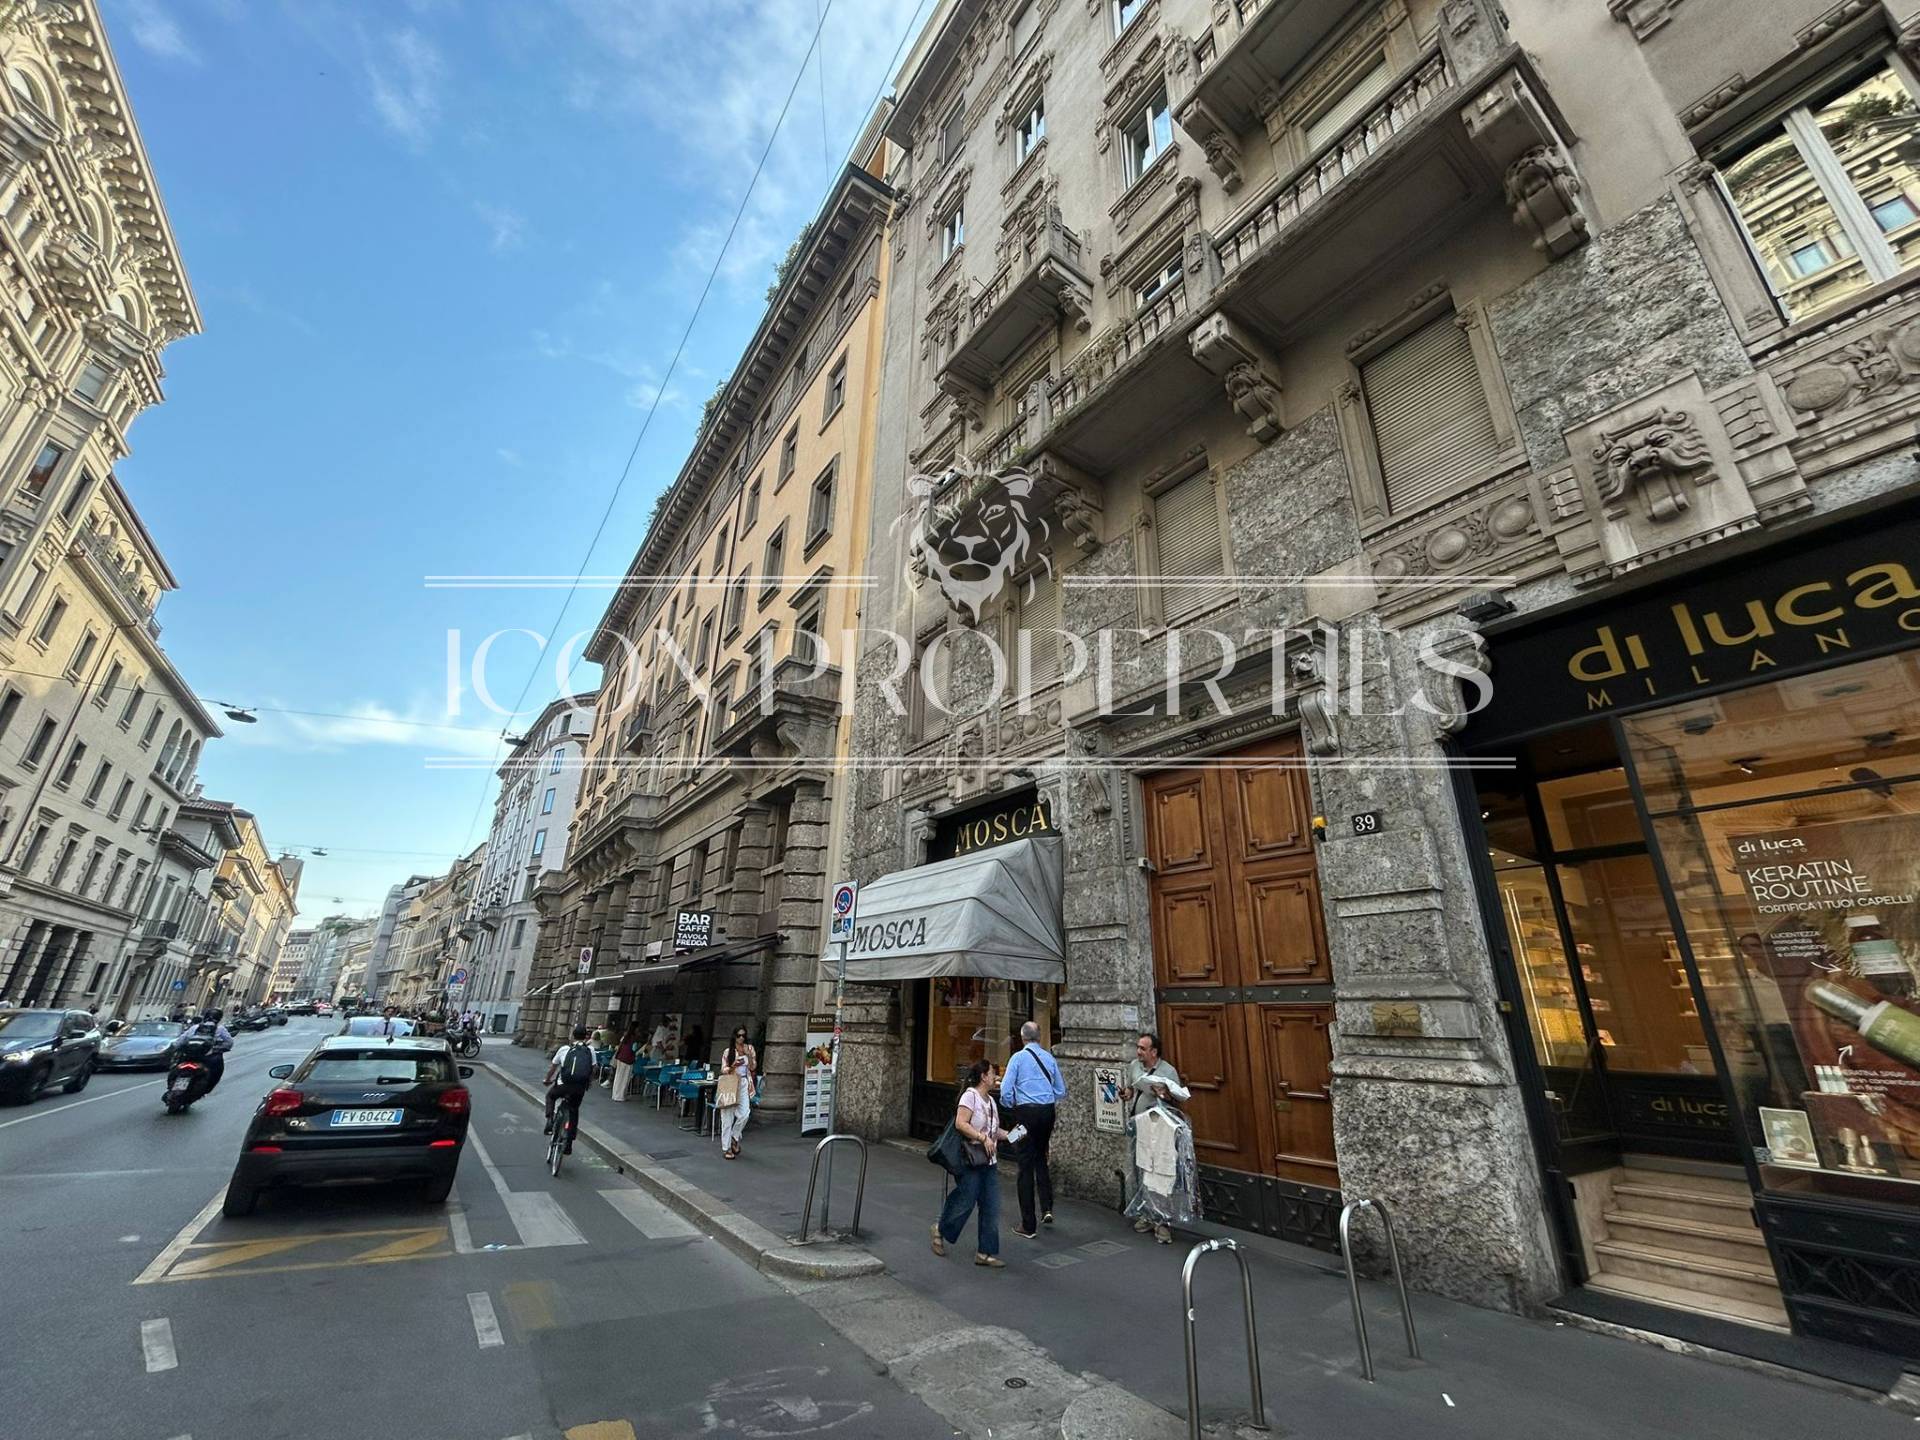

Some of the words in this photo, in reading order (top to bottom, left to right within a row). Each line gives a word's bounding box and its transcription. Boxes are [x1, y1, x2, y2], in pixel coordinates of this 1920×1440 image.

[1568, 625, 1649, 682] di
[1671, 562, 1920, 656] luca
[1587, 608, 1920, 710] MILANO
[954, 805, 1048, 855] MOSCA
[1354, 814, 1376, 832] 39
[1737, 841, 1756, 853] di
[1760, 837, 1805, 851] luca
[1746, 859, 1853, 884] KERATIN
[1752, 875, 1872, 901] ROUTINE
[1758, 901, 1814, 914] FORTIFICA
[1824, 899, 1855, 910] TUOI
[679, 912, 711, 925] BAR
[676, 939, 708, 947] FREDDA
[677, 932, 708, 940] TAVOLA
[850, 917, 927, 953] MOSCA
[341, 1111, 358, 1122] FV
[359, 1110, 395, 1122] 604CZ
